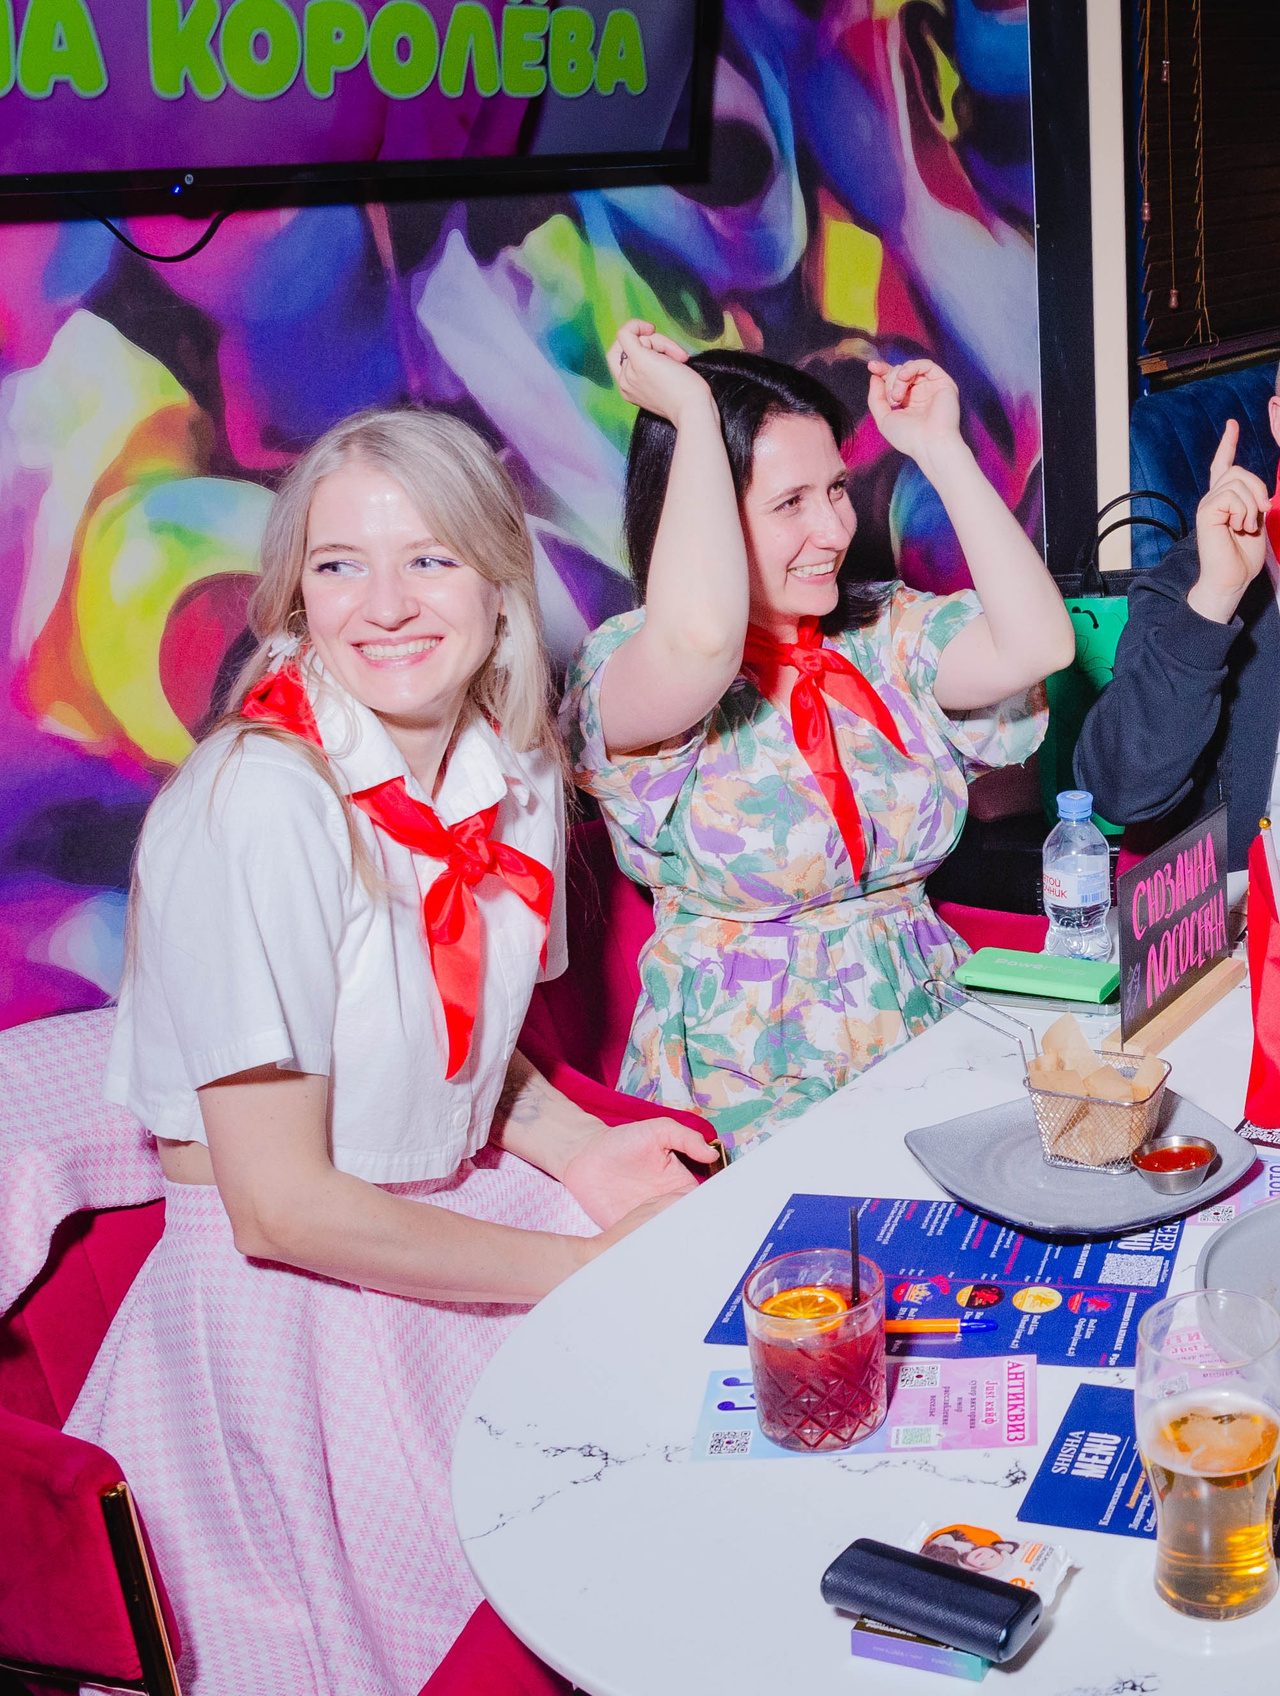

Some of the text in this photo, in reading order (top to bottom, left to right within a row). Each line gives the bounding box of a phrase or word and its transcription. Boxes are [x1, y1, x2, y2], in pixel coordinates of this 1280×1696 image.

[149, 0, 648, 101] КОРОЛЁВА
[1131, 831, 1218, 941] СЮЗАННА
[1145, 888, 1227, 1009] ЛОСОСЕВНА
[1151, 1221, 1179, 1252] EER
[942, 1386, 952, 1425] расслабление
[981, 1380, 1000, 1425] Just кайф
[1006, 1360, 1026, 1442] АНТИКВИЗ
[1051, 1430, 1085, 1475] SHISHA
[1071, 1431, 1122, 1480] MENU
